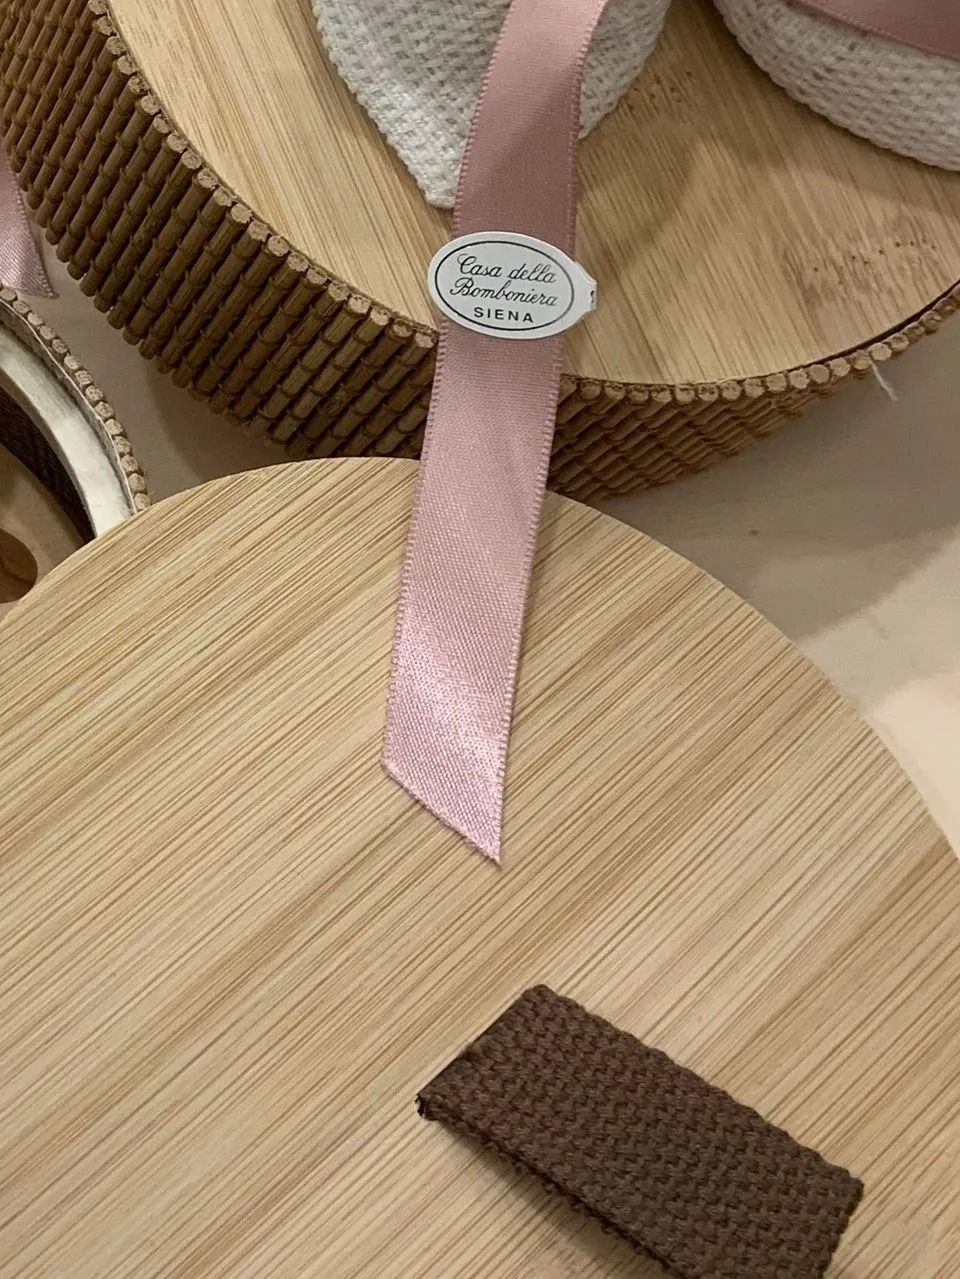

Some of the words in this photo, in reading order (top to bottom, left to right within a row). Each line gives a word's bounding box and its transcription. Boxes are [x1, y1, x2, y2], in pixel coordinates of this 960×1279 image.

[457, 253, 502, 278] Casa
[503, 263, 556, 284] della
[450, 277, 558, 306] Bomboniera
[474, 306, 534, 323] SIENA
